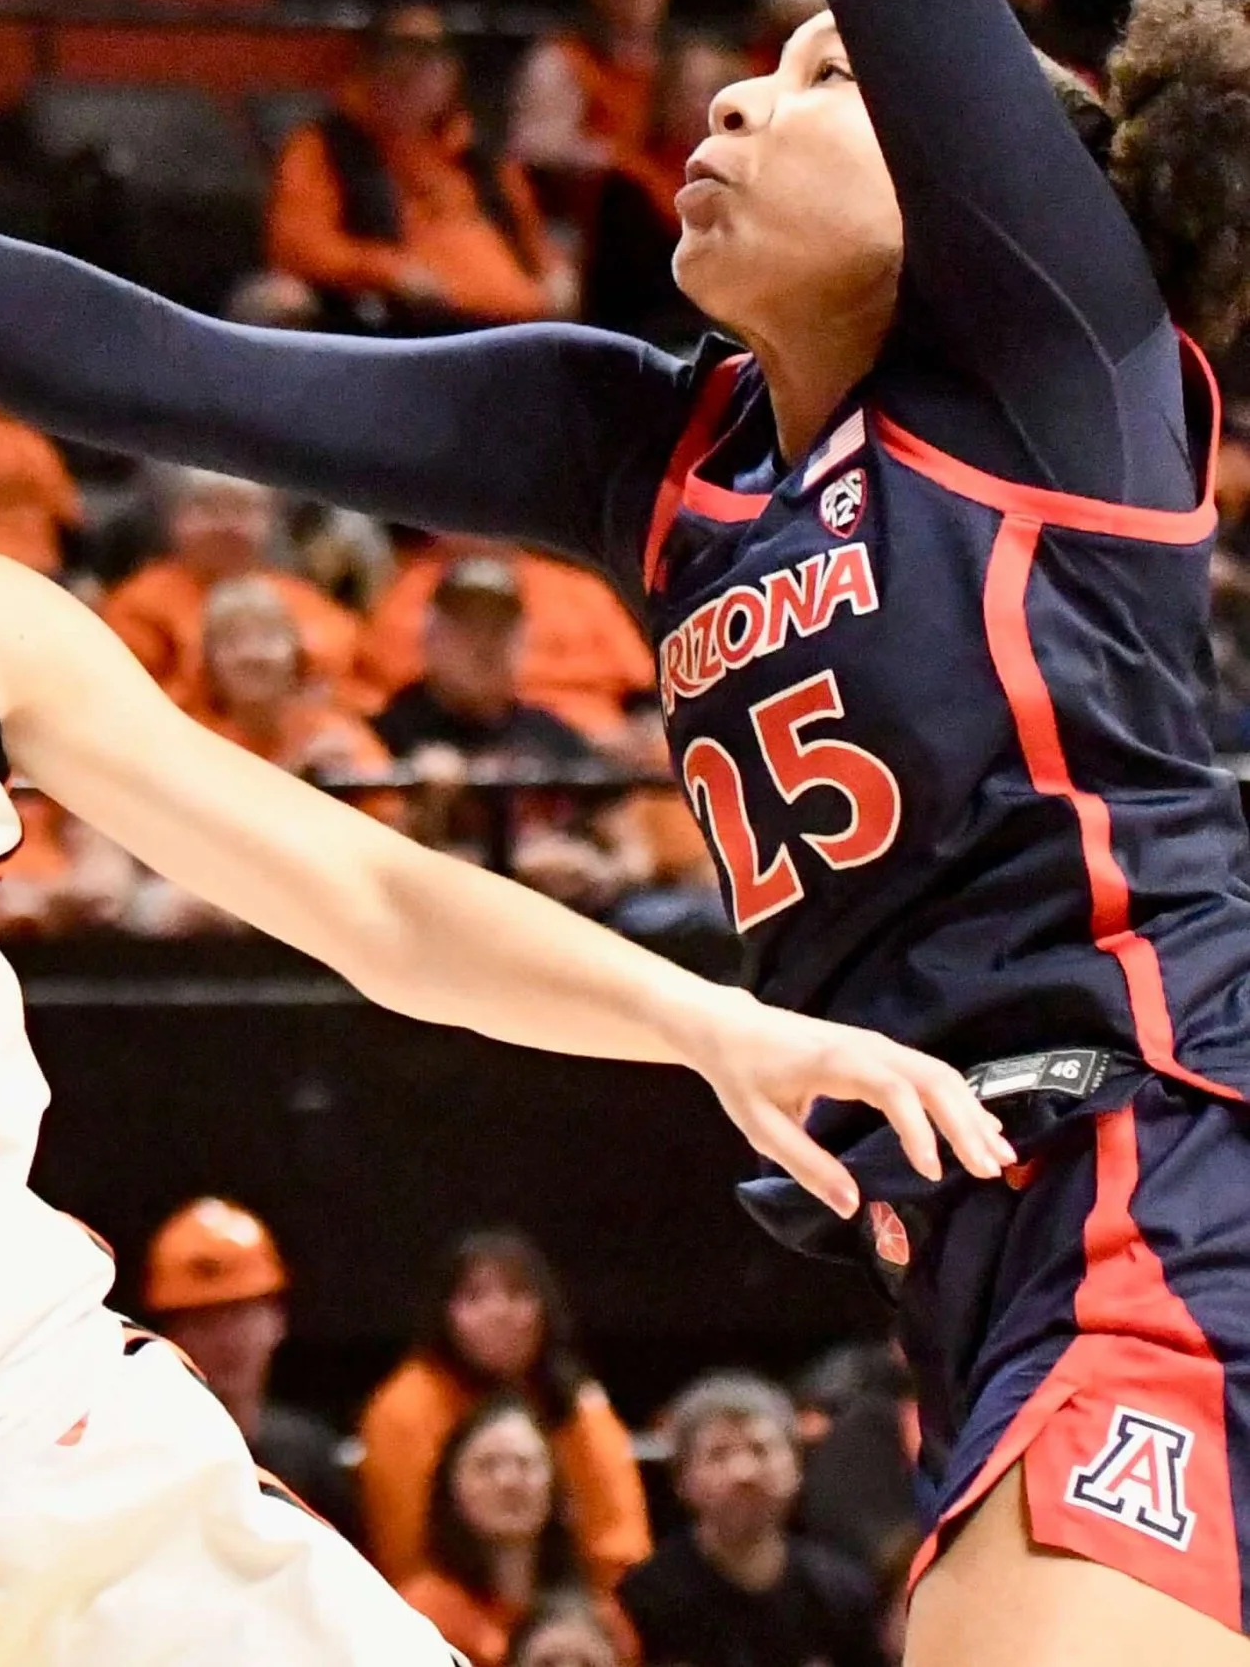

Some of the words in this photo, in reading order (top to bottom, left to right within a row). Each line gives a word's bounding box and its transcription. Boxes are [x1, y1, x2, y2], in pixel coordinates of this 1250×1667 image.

[683, 669, 901, 934] 25
[1049, 1059, 1082, 1079] 46
[1064, 1404, 1197, 1553] A
